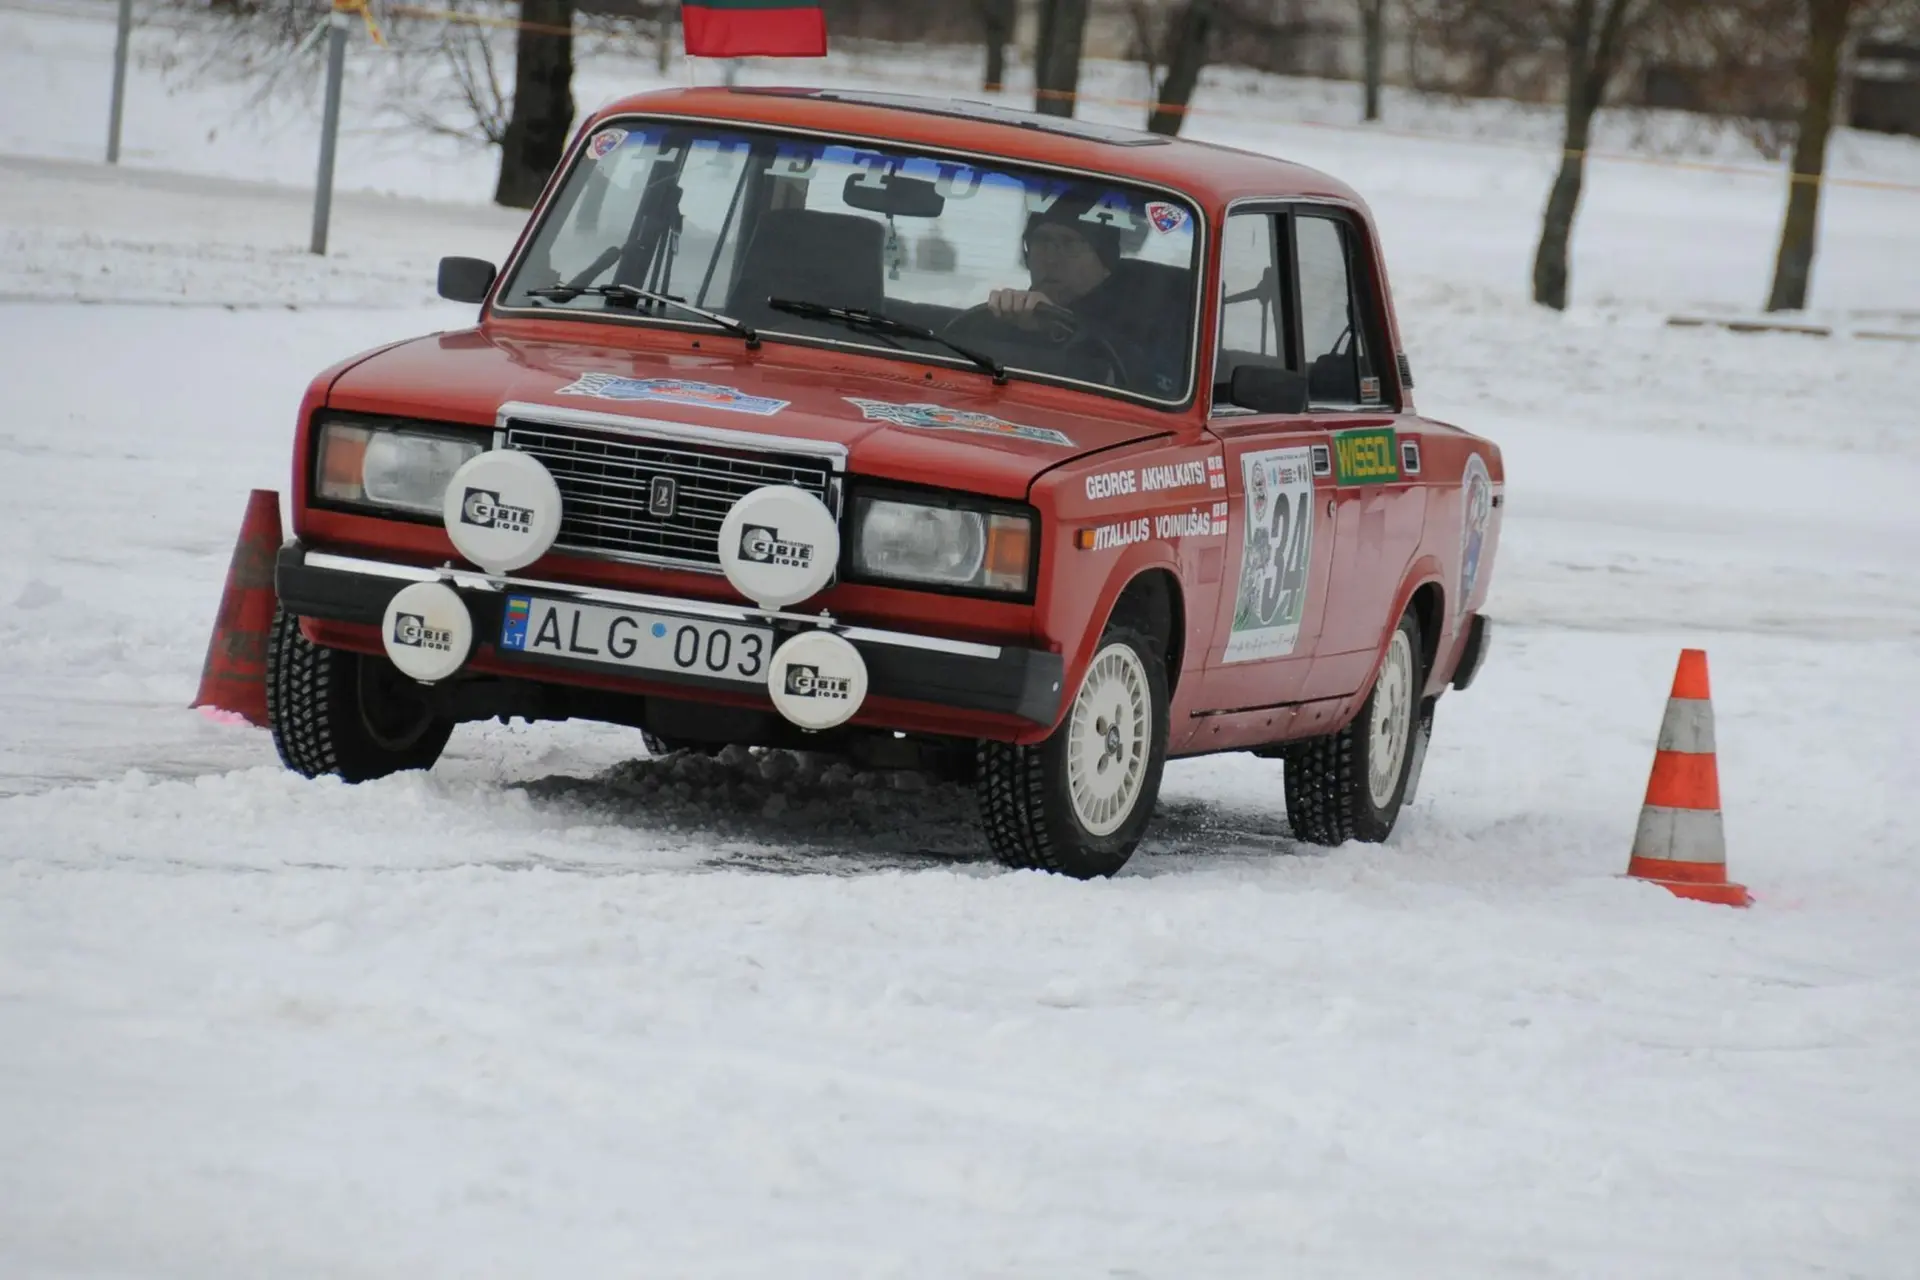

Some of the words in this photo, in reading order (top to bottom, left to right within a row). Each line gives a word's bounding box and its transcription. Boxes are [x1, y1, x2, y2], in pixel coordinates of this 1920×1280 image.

[1335, 436, 1396, 478] WISSOL
[1085, 469, 1137, 500] GEORGE
[1142, 460, 1206, 492] AKHALKATSI
[496, 521, 529, 533] IODE
[775, 557, 809, 568] IODE
[1260, 492, 1308, 624] 34
[503, 631, 524, 647] LT
[533, 606, 639, 659] ALG
[674, 625, 763, 677] 003
